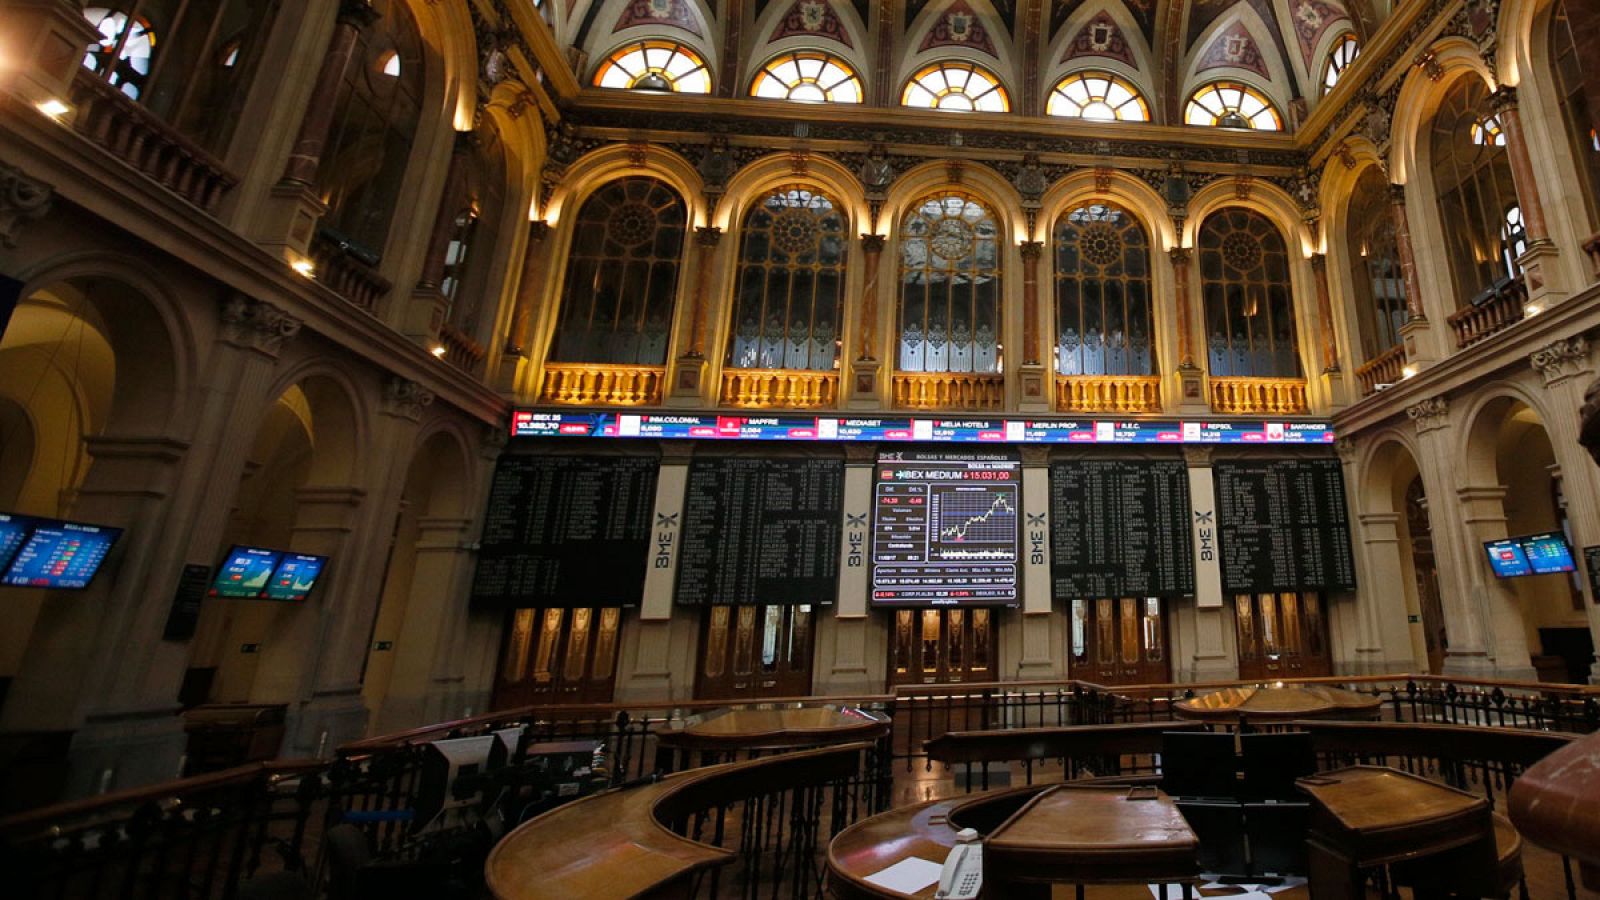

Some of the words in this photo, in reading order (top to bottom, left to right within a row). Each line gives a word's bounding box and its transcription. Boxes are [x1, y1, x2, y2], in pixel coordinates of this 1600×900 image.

[924, 470, 962, 479] MEDIUM
[970, 471, 1009, 480] 15.031,00
[655, 532, 673, 568] BME
[848, 532, 862, 567] BME
[1030, 531, 1044, 564] BME
[1199, 528, 1213, 560] BME
